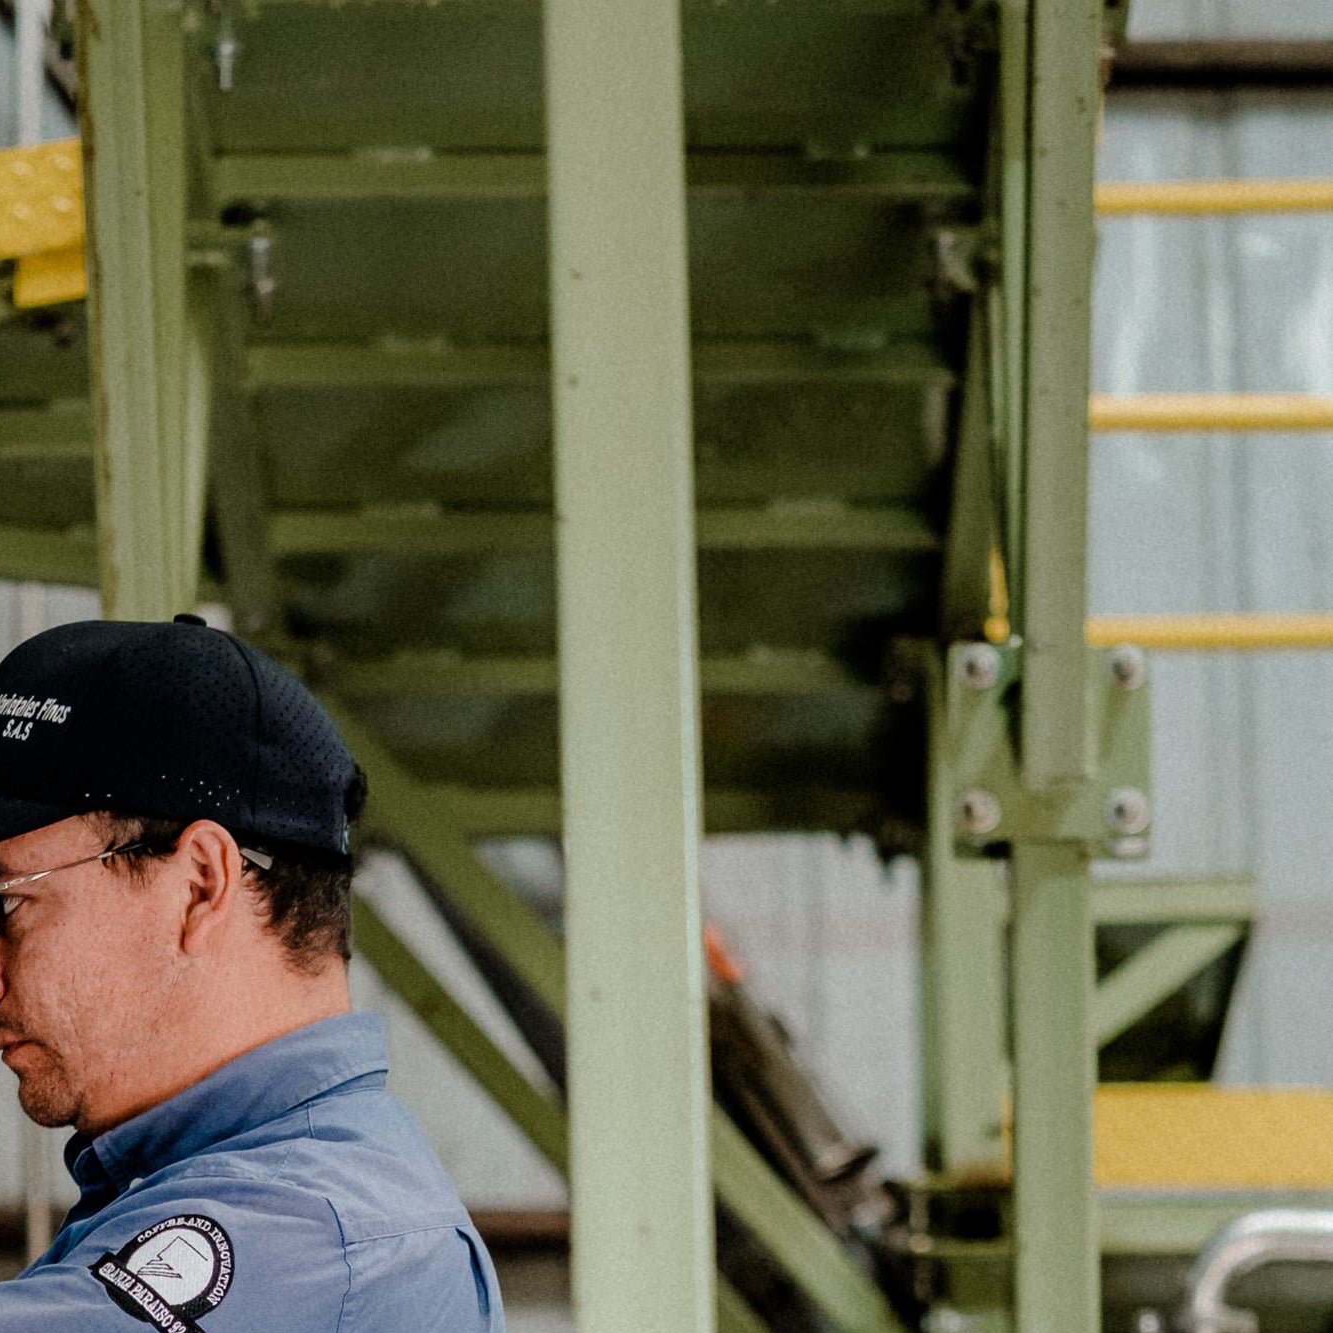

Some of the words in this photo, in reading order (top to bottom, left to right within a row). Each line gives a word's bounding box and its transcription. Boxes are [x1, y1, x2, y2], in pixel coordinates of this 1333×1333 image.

[36, 698, 72, 724] Finos
[137, 1217, 186, 1243] COFFEE
[184, 1217, 212, 1232] AND
[207, 1227, 232, 1306] INNOVATION
[128, 1282, 175, 1328] PARAISO
